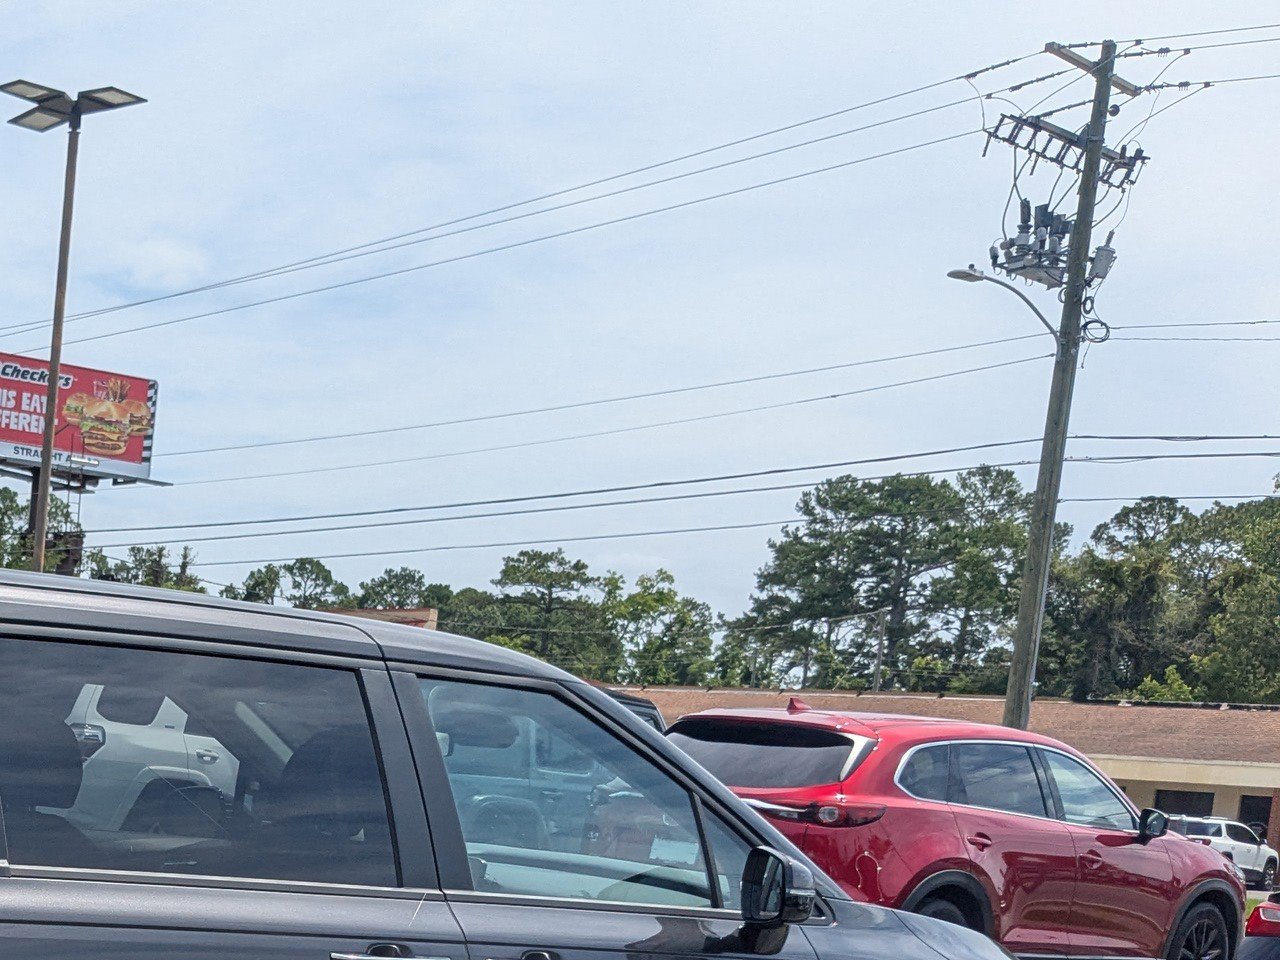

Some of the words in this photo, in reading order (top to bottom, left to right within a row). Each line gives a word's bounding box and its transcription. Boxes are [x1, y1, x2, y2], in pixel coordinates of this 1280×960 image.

[1, 364, 72, 387] Checkrs
[21, 392, 49, 414] EAT
[13, 445, 63, 461] STRAHT
